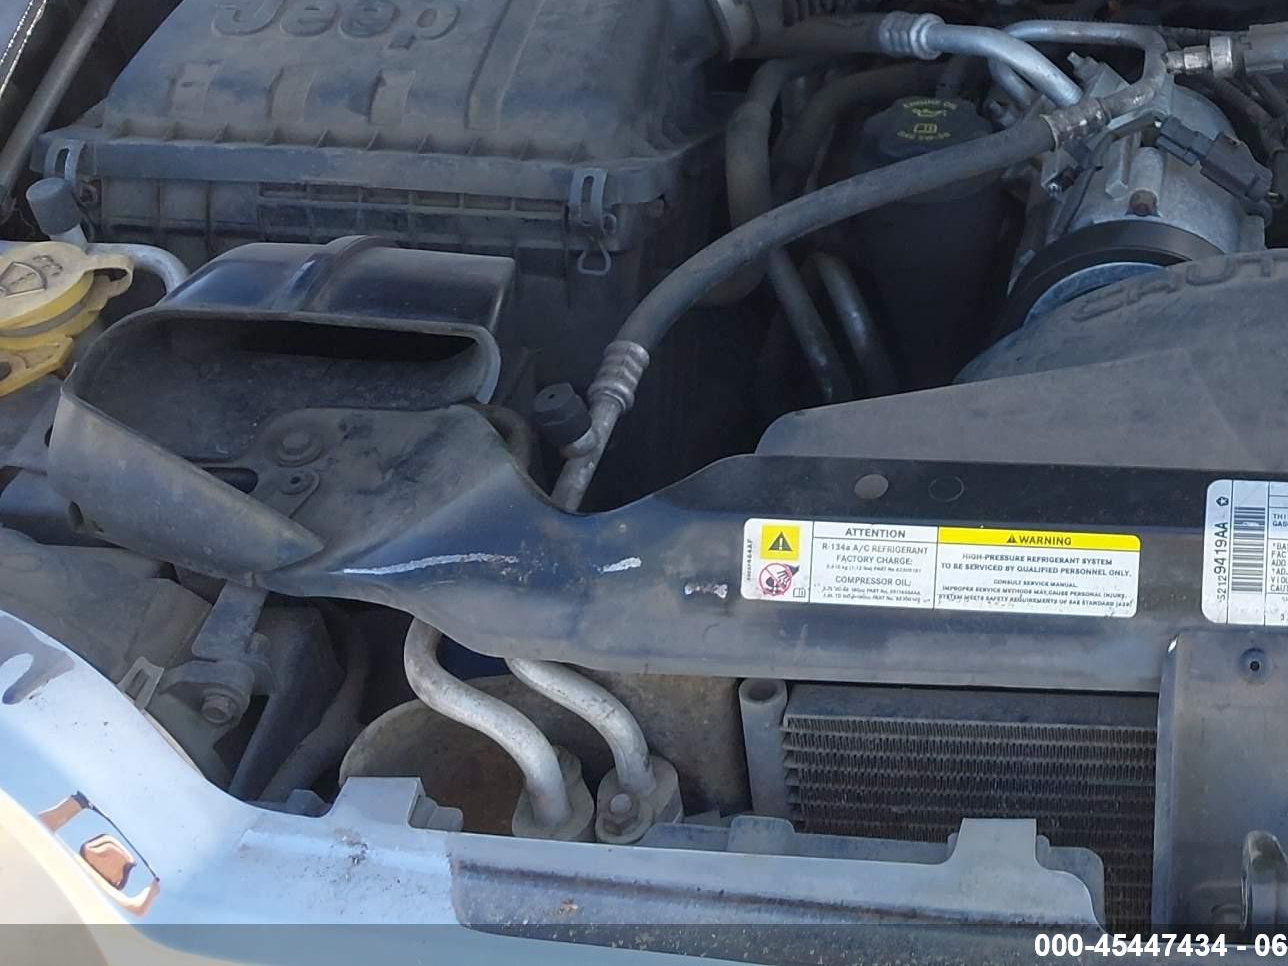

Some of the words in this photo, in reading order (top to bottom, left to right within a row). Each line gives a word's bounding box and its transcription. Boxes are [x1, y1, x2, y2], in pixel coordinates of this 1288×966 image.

[845, 528, 906, 538] ATTENTION
[1018, 535, 1072, 546] WARNING
[822, 542, 850, 552] R-134a
[852, 543, 870, 553] A/C
[871, 544, 929, 555] REFRIGERANT
[836, 554, 874, 564] FACTORY
[876, 555, 913, 566] CHARGE:
[962, 553, 1025, 562] HIGH-PRESSURE
[1026, 555, 1080, 564] REFRIGERANT
[1082, 558, 1113, 566] SYSTEM
[941, 562, 951, 570] TO
[965, 563, 1003, 572] SERVICED
[1016, 565, 1058, 574] QUALIFIED
[1060, 567, 1107, 576] PERSONNEL
[1108, 569, 1132, 577] ONLY.
[835, 575, 892, 586] COMPRESSOR
[894, 577, 911, 587] OIL:
[993, 578, 1021, 586] CONSULT
[1022, 579, 1049, 587] SERVICE
[975, 586, 1001, 594] SERVICE
[1009, 596, 1058, 604] REQUIREMENTS
[1082, 599, 1115, 607] STANDARD
